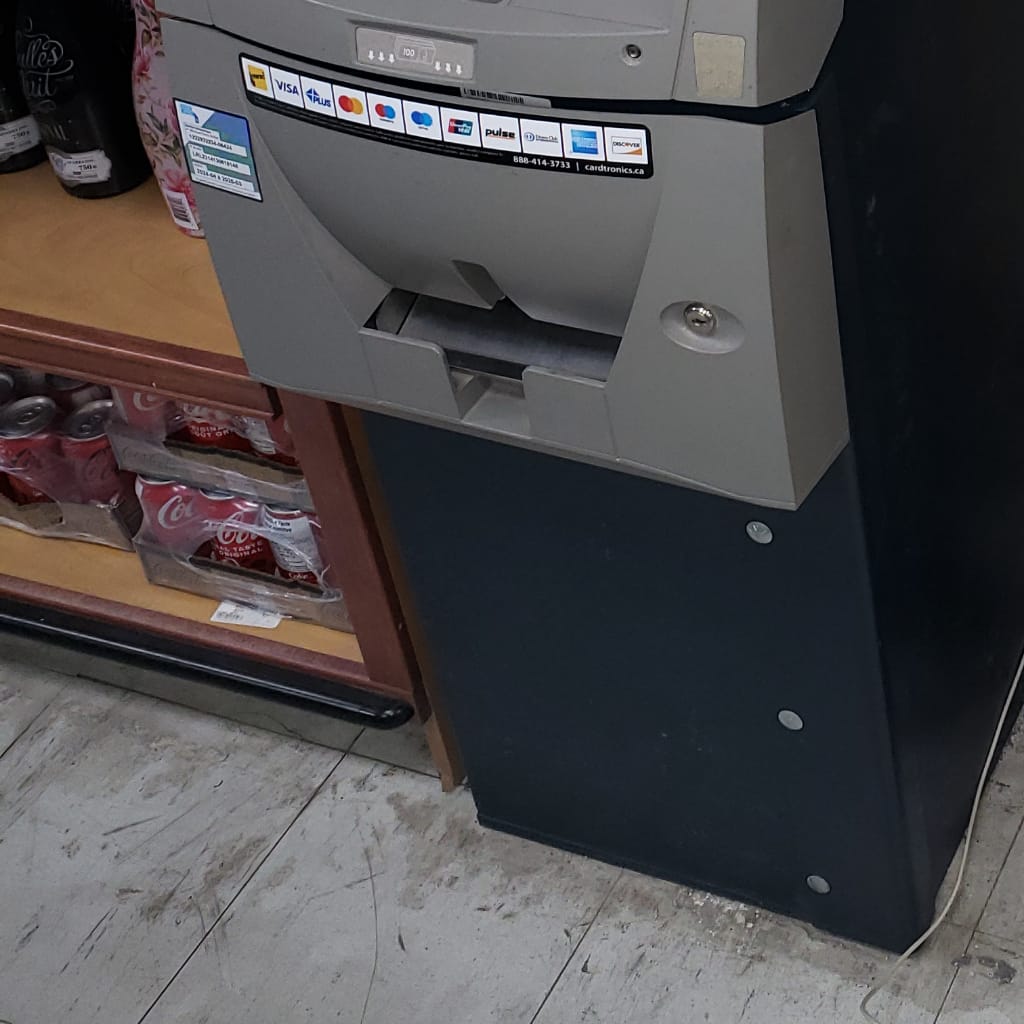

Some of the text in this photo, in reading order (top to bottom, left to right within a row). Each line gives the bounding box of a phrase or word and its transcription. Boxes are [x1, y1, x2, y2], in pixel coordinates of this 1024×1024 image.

[274, 78, 300, 97] VISA
[313, 95, 332, 108] PLUS
[485, 127, 516, 139] pulse
[612, 140, 641, 149] DISCOVER
[513, 156, 571, 169] 888-414-3733
[584, 163, 645, 175] cardtronics.ca
